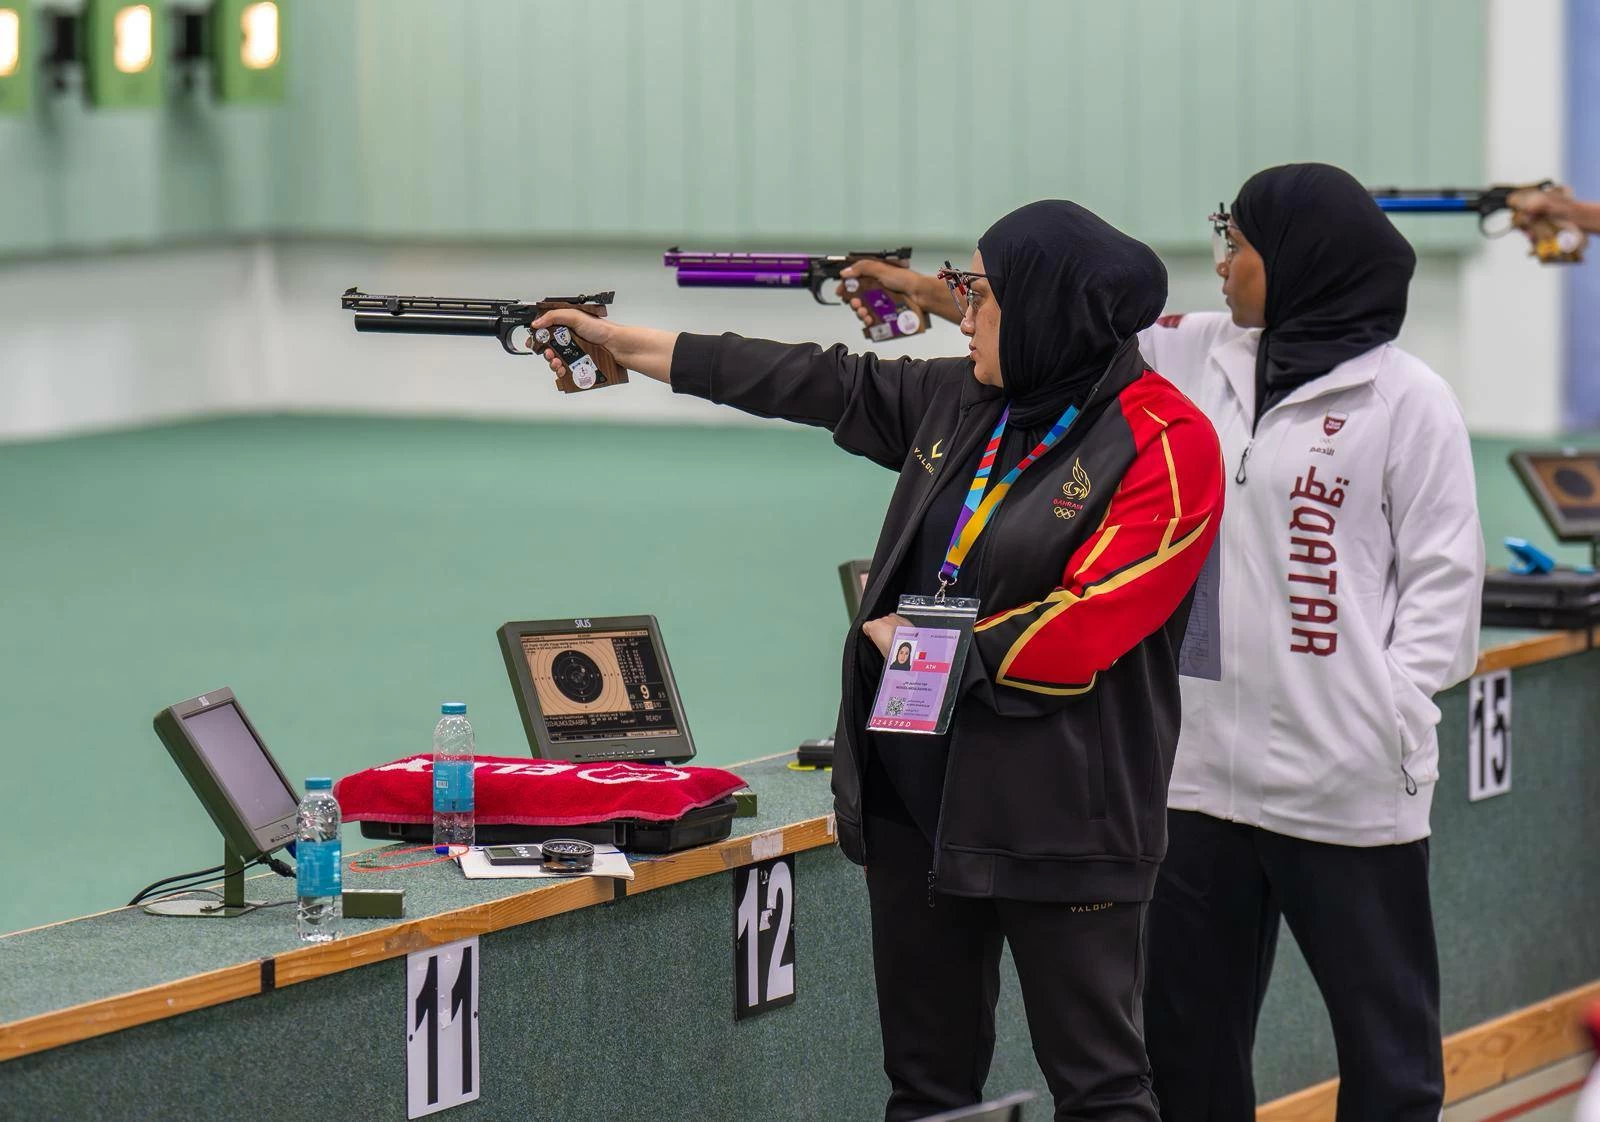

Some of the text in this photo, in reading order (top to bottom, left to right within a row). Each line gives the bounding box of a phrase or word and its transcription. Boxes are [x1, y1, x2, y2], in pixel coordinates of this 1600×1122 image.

[914, 447, 935, 475] VALOU
[1290, 465, 1350, 509] قطر
[1288, 506, 1338, 657] QATAR
[640, 684, 650, 700] 9
[1473, 677, 1507, 789] 15
[738, 861, 794, 1007] 12
[415, 946, 472, 1105] 11
